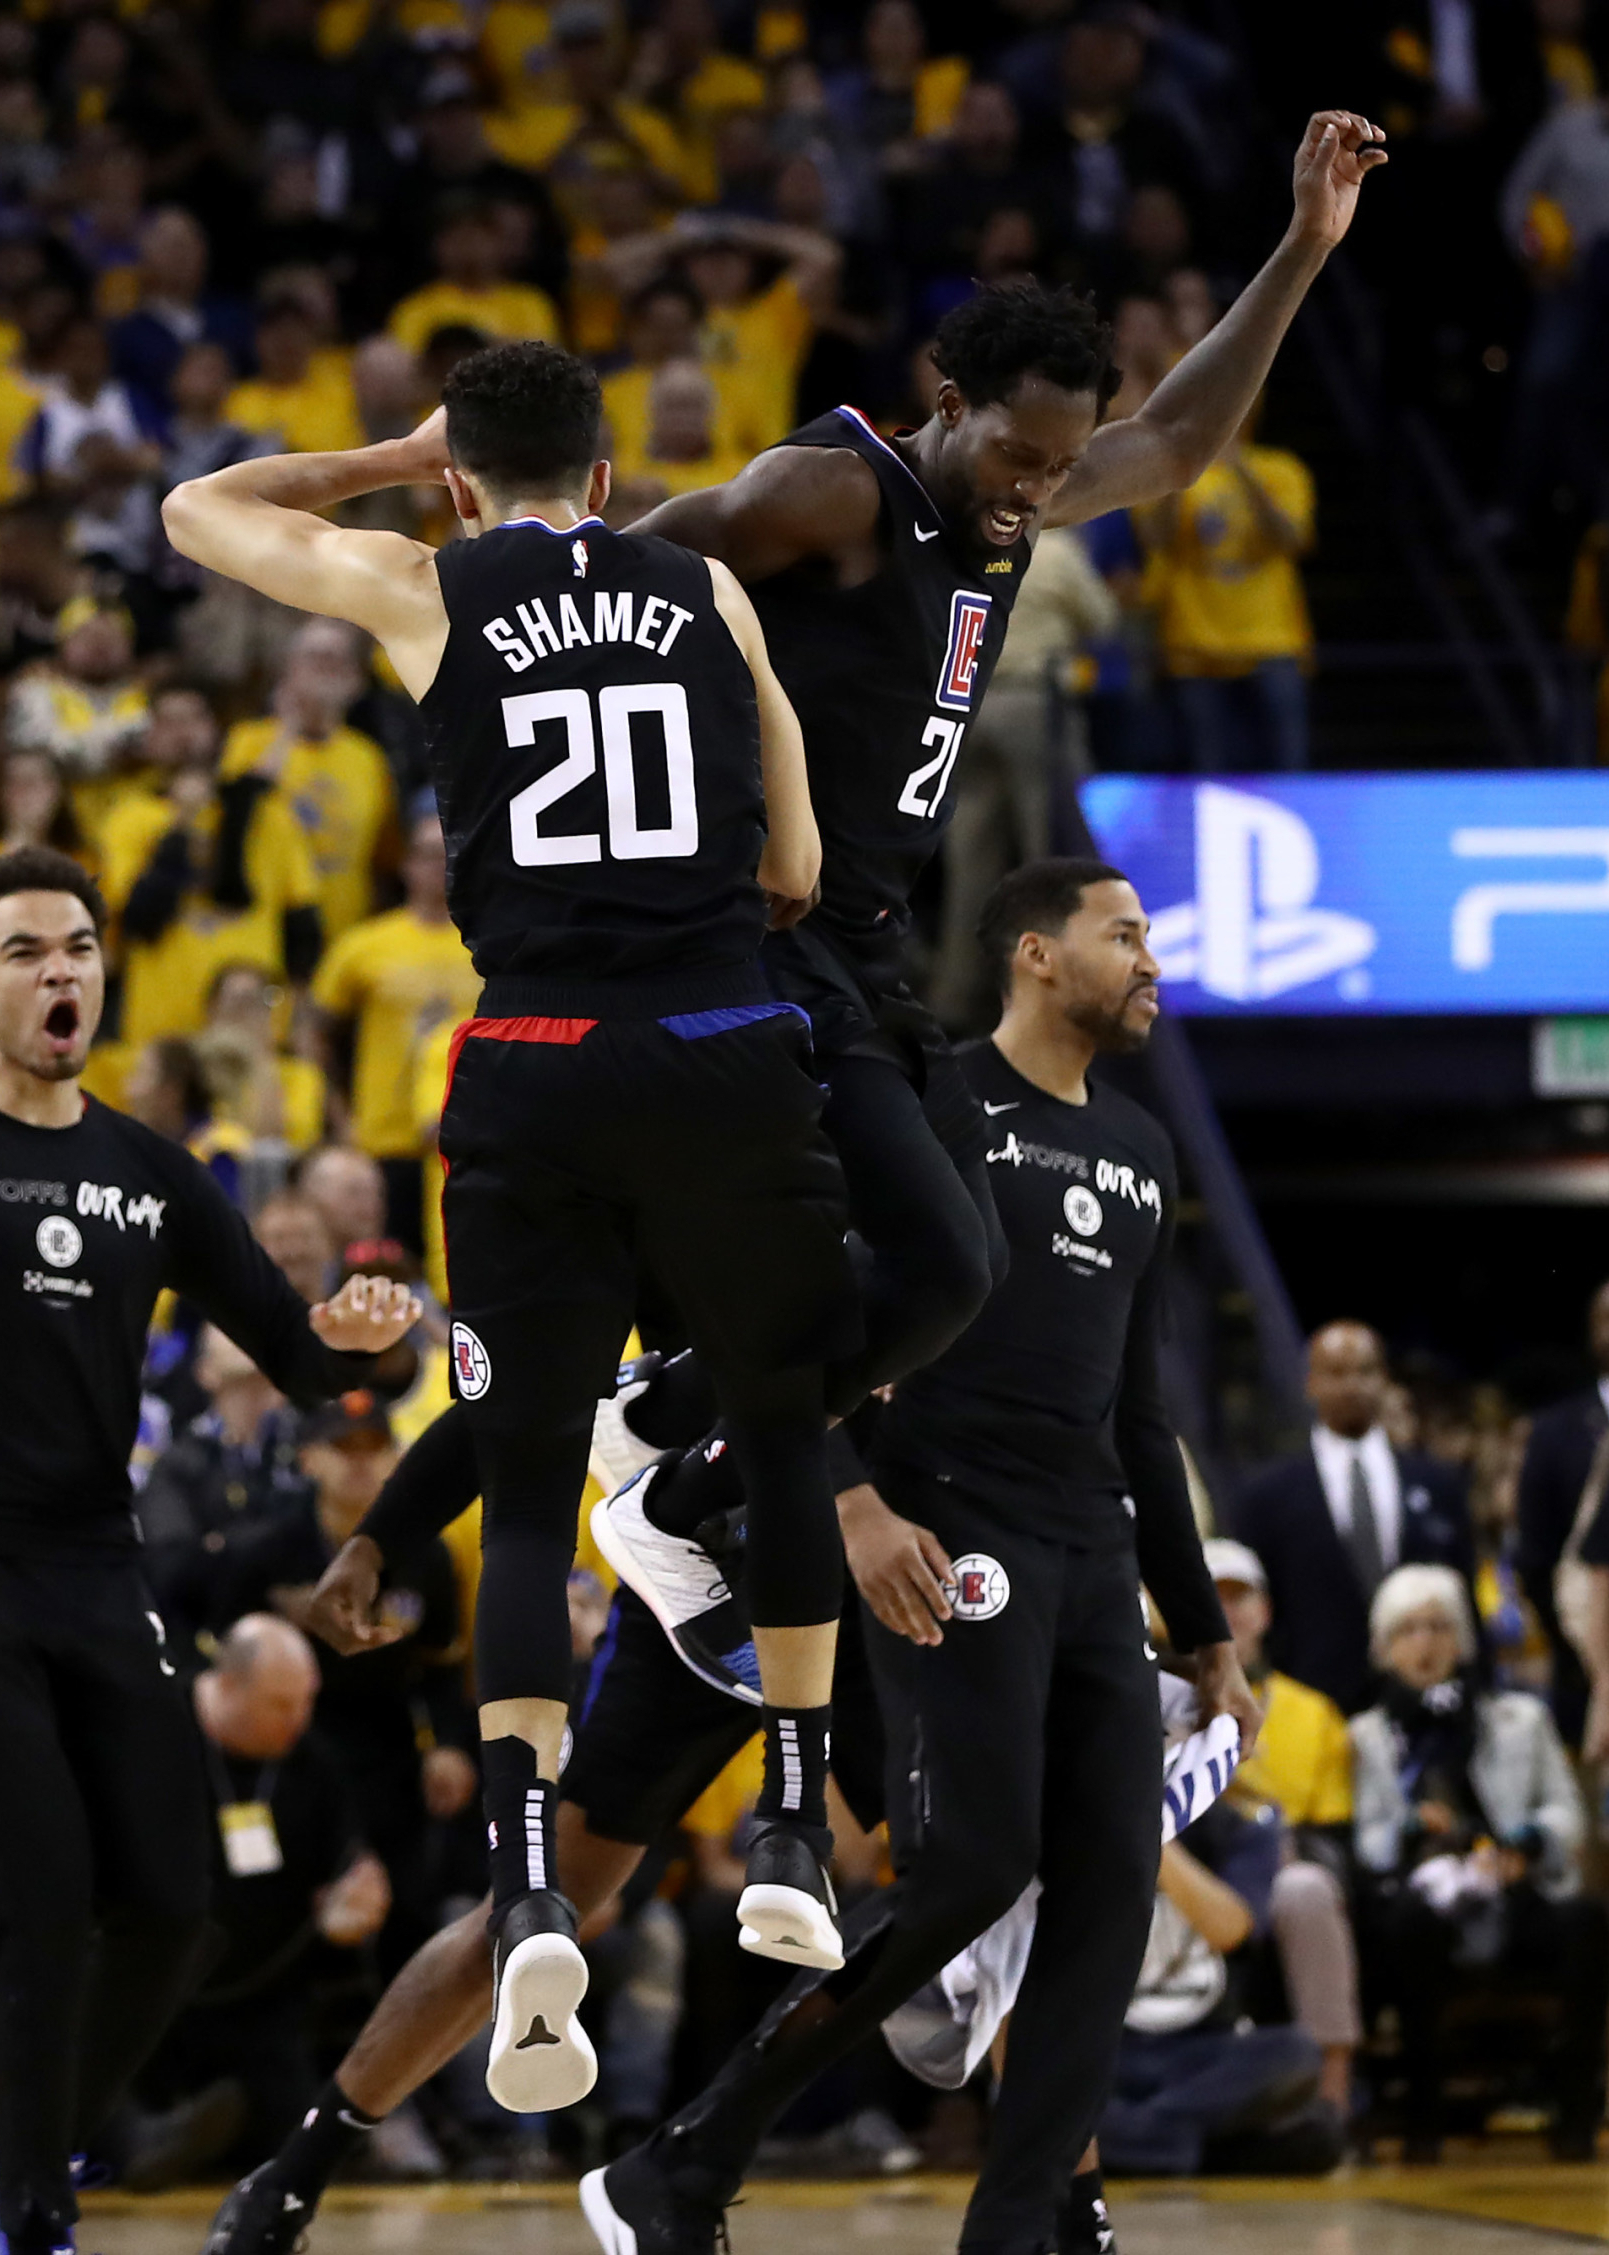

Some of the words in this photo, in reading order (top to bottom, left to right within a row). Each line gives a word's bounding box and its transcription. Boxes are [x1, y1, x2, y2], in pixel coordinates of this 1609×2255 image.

[482, 592, 694, 673] SHAMET
[501, 683, 698, 867] 20
[898, 716, 965, 818] 21
[76, 1180, 126, 1232] OUR
[1096, 1158, 1141, 1210] OUR
